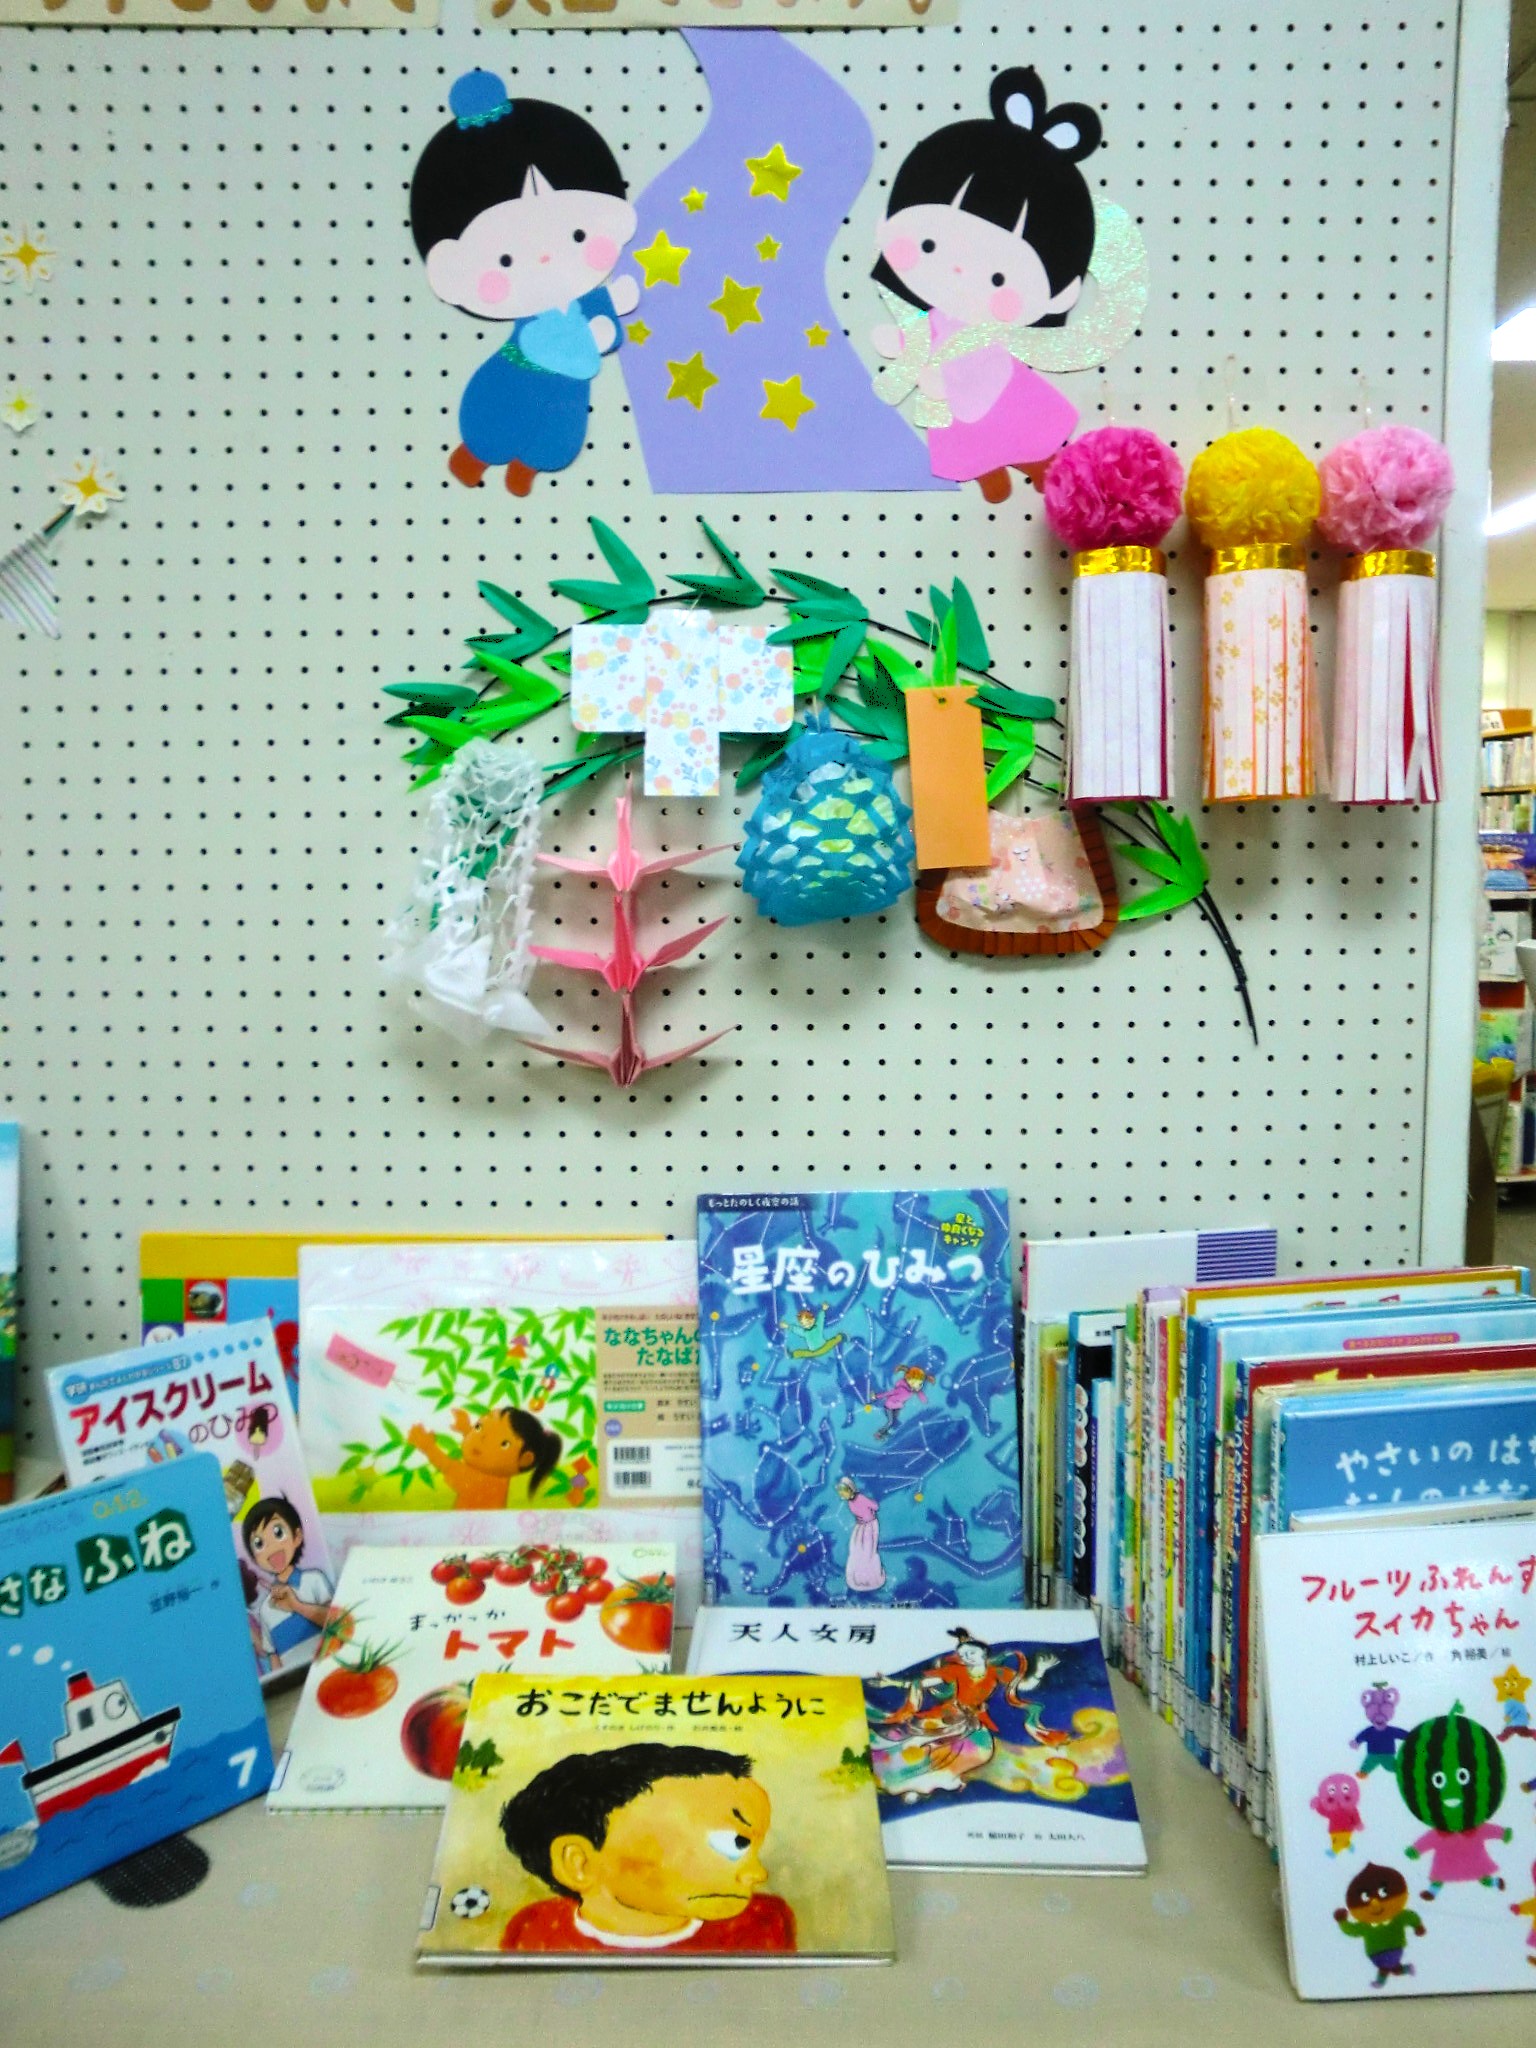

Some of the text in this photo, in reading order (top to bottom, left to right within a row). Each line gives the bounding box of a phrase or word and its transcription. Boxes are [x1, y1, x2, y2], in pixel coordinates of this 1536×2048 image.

[732, 1244, 984, 1295] 星座のひみつ
[69, 1360, 273, 1447] アイスクリーム
[408, 1608, 507, 1631] まっかっか
[731, 1622, 877, 1645] 天人女房
[1354, 1601, 1520, 1639] スイカちゃん
[444, 1628, 576, 1661] トマト
[516, 1688, 827, 1719] おこだでませんように
[228, 1747, 258, 1789] 7
